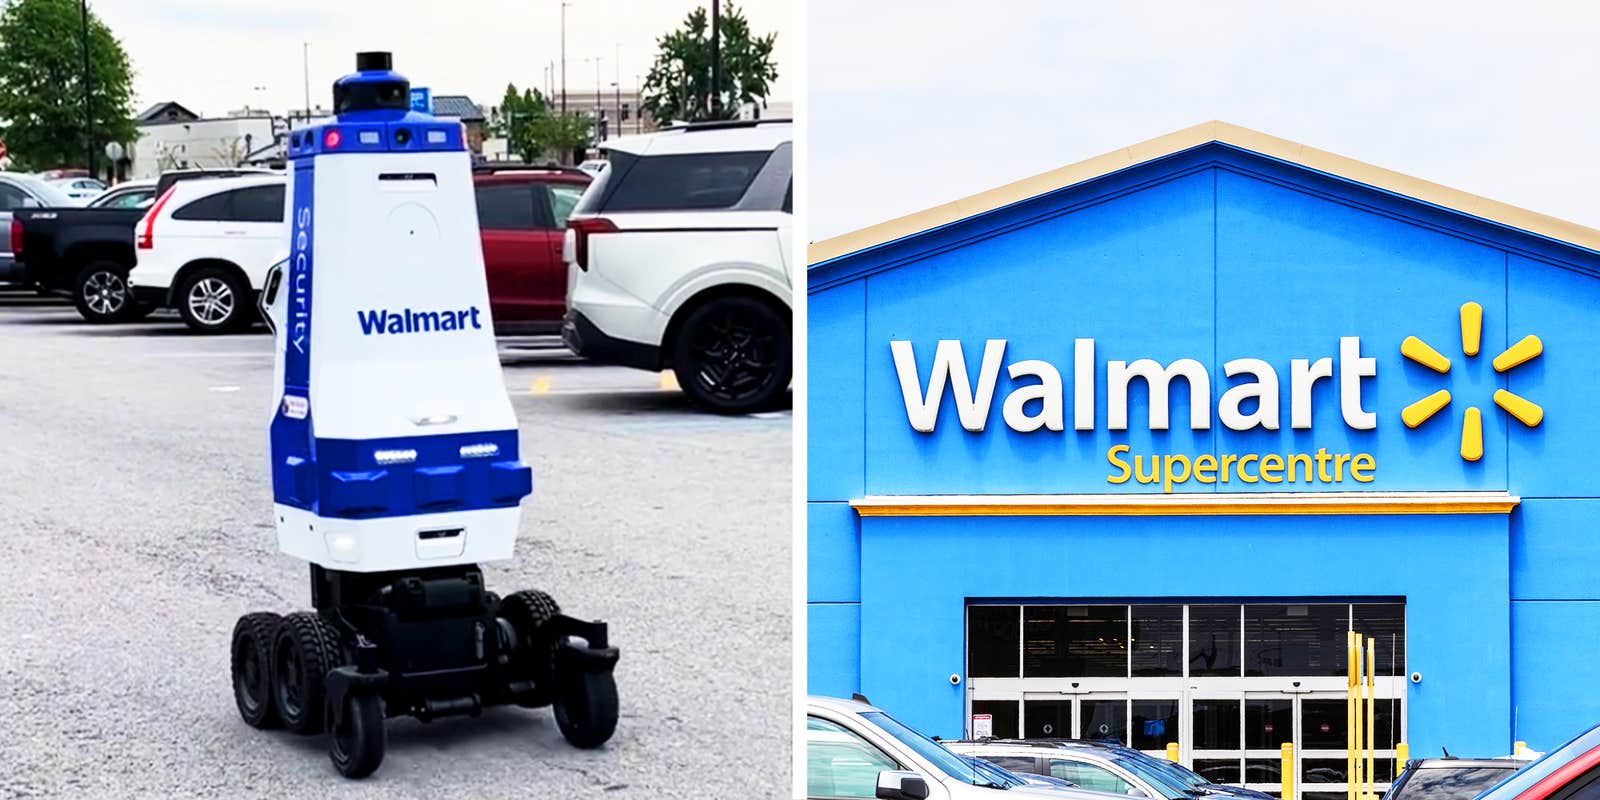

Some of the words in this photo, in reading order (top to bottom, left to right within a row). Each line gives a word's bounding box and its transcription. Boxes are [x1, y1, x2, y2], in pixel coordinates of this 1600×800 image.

[293, 207, 311, 354] Security
[357, 306, 481, 336] Walmart
[890, 336, 1377, 432] Walmart
[1106, 445, 1377, 493] Supercentre
